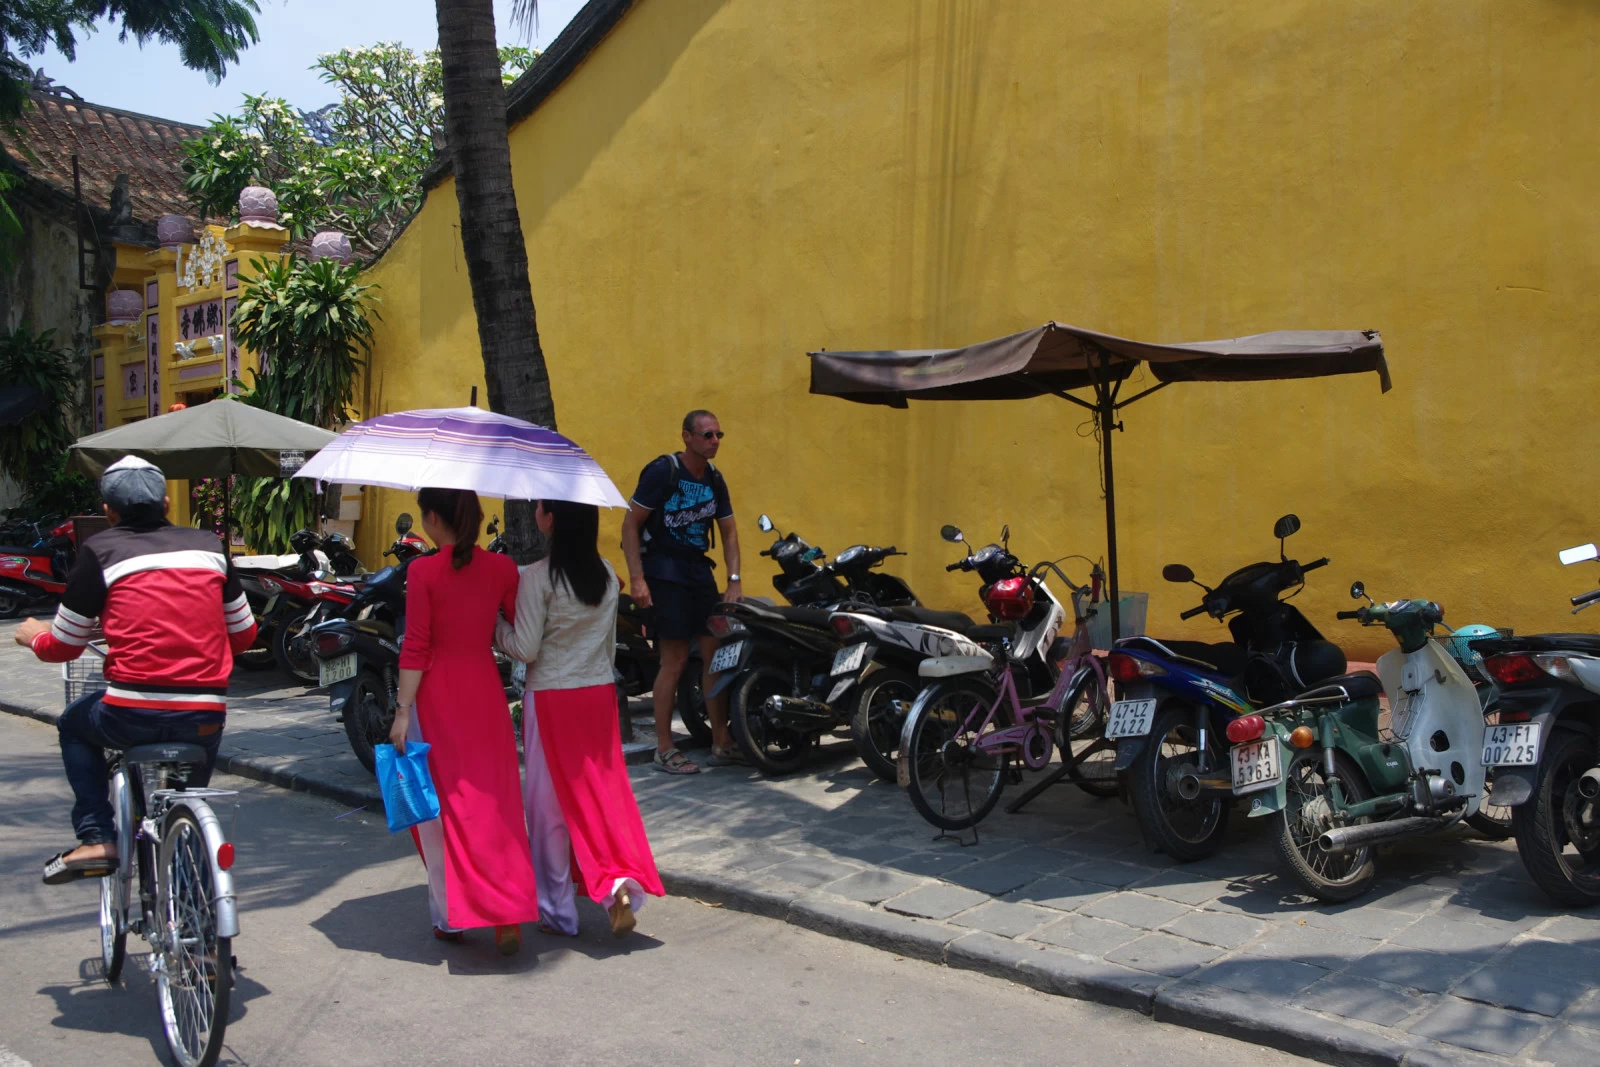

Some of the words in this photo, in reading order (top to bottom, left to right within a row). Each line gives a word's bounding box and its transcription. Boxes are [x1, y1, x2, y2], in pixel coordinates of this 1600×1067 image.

[326, 666, 351, 682] 1200
[1111, 719, 1145, 735] 2422
[1484, 745, 1535, 764] 002.25
[1239, 761, 1271, 783] 5363
